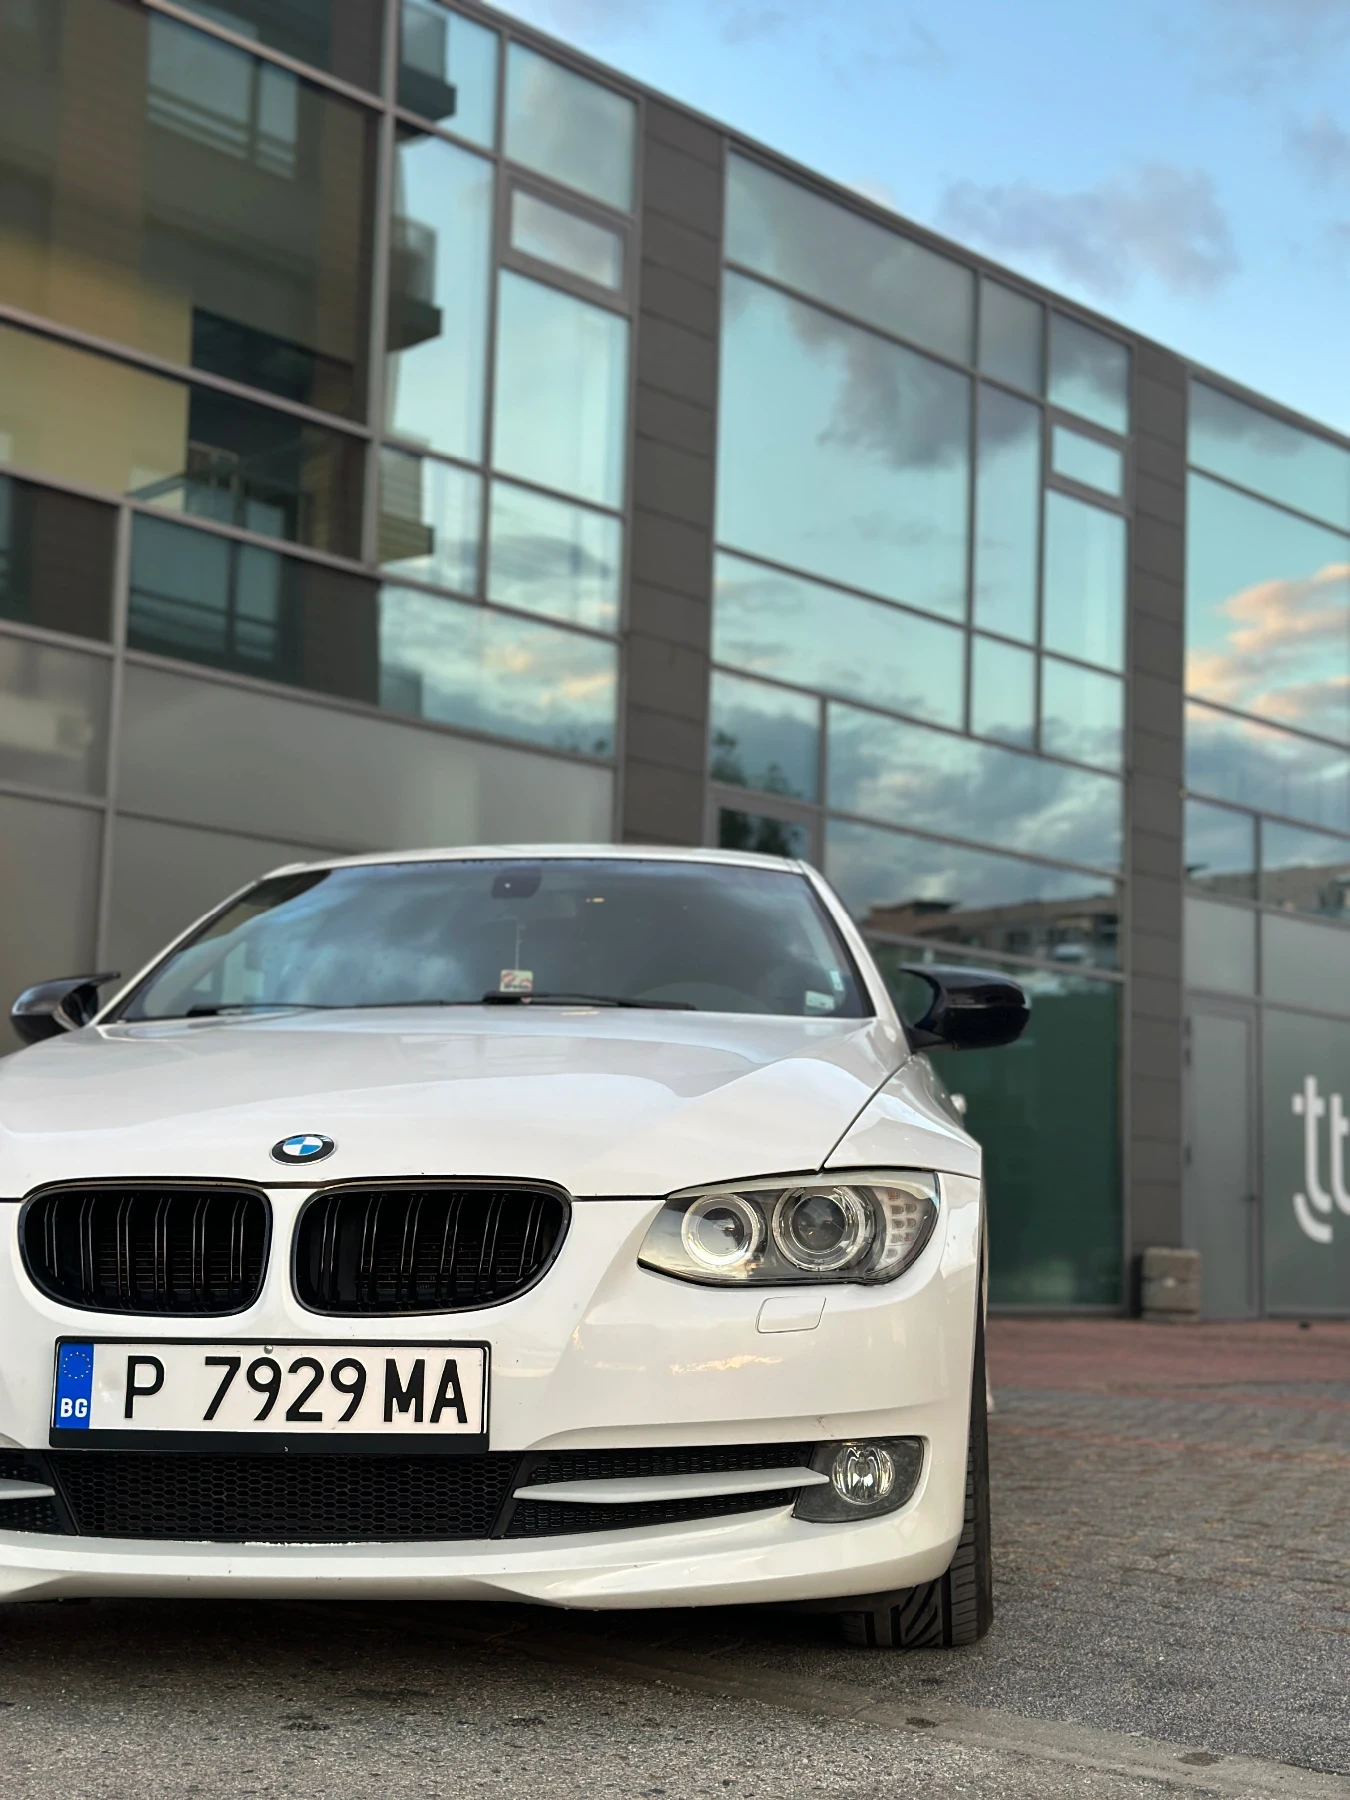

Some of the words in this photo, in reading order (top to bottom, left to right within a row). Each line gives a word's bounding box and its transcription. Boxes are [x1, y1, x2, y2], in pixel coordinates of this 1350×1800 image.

[60, 1397, 88, 1418] BG
[124, 1355, 165, 1419] P
[203, 1356, 367, 1422] 7929
[383, 1358, 468, 1424] MA
